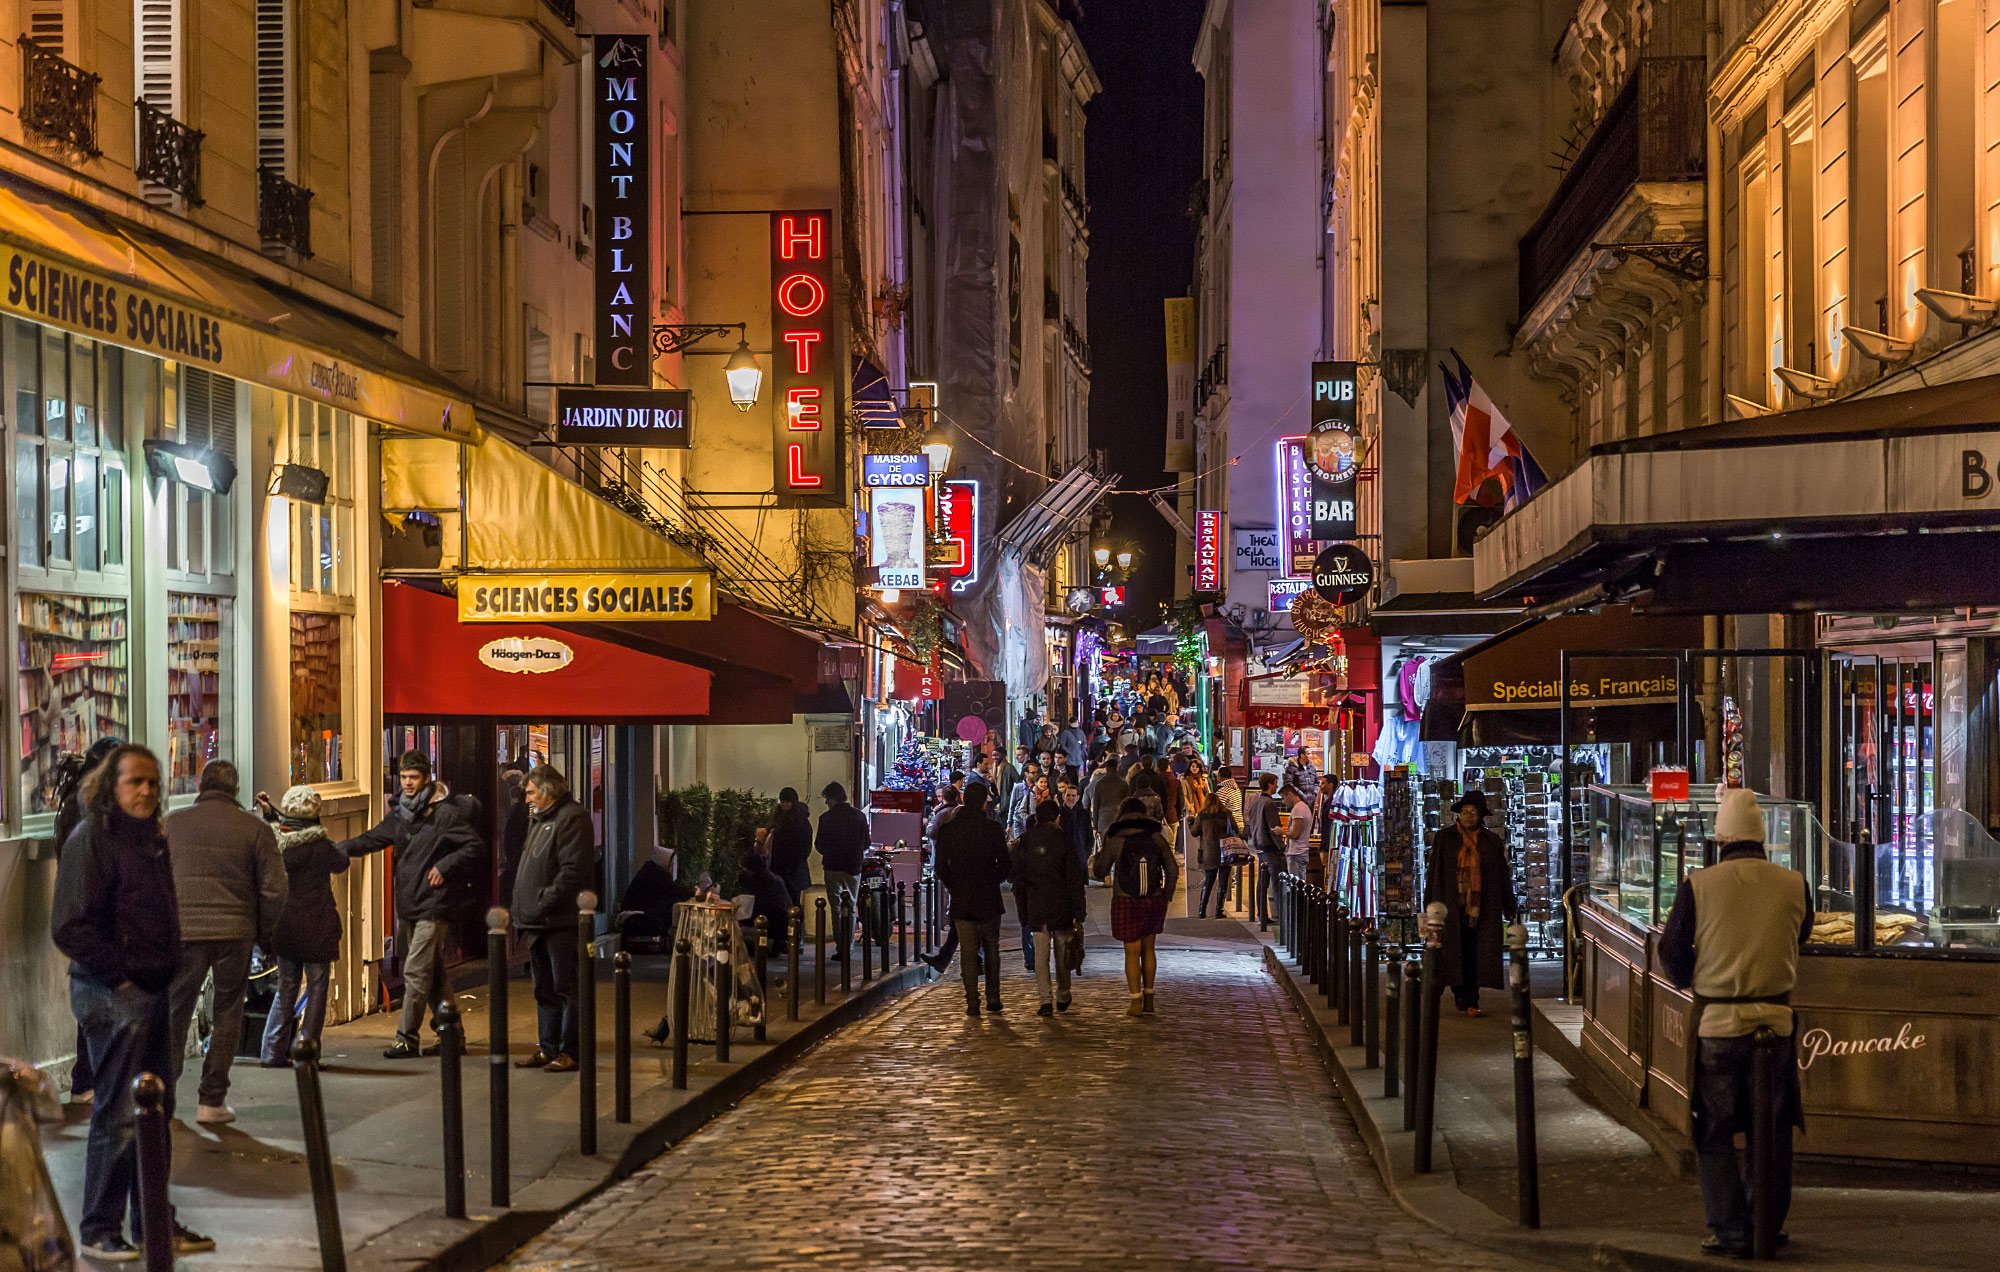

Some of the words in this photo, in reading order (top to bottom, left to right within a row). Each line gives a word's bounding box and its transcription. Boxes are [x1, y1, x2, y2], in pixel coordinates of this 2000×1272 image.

[605, 77, 637, 199] MONT
[610, 216, 634, 370] BLANC
[8, 254, 118, 334] SCIENCES
[127, 294, 222, 364] SOCIALES
[779, 216, 824, 489] HOTEL
[1316, 381, 1353, 401] PUB
[563, 408, 623, 428] JARDIN
[626, 409, 650, 429] DU
[653, 409, 683, 429] ROI
[1319, 421, 1350, 433] BULL'S
[873, 455, 917, 463] MAISON
[889, 465, 901, 473] DE
[867, 474, 925, 486] GYROS
[1962, 450, 2000, 499] B
[1291, 446, 1303, 525] BISTRO
[1315, 501, 1354, 521] BAR
[1294, 531, 1302, 539] DE
[1201, 512, 1215, 589] RESTAURANT
[1295, 545, 1302, 553] LA
[878, 575, 919, 586] KEBAB
[1316, 573, 1369, 586] GUINNESS
[476, 587, 578, 613] SCIENCES
[587, 587, 693, 613] SOCIALES
[1291, 588, 1318, 614] BISTRO
[1493, 680, 1589, 702] Spécialiés
[1797, 1022, 1927, 1070] Pancake
